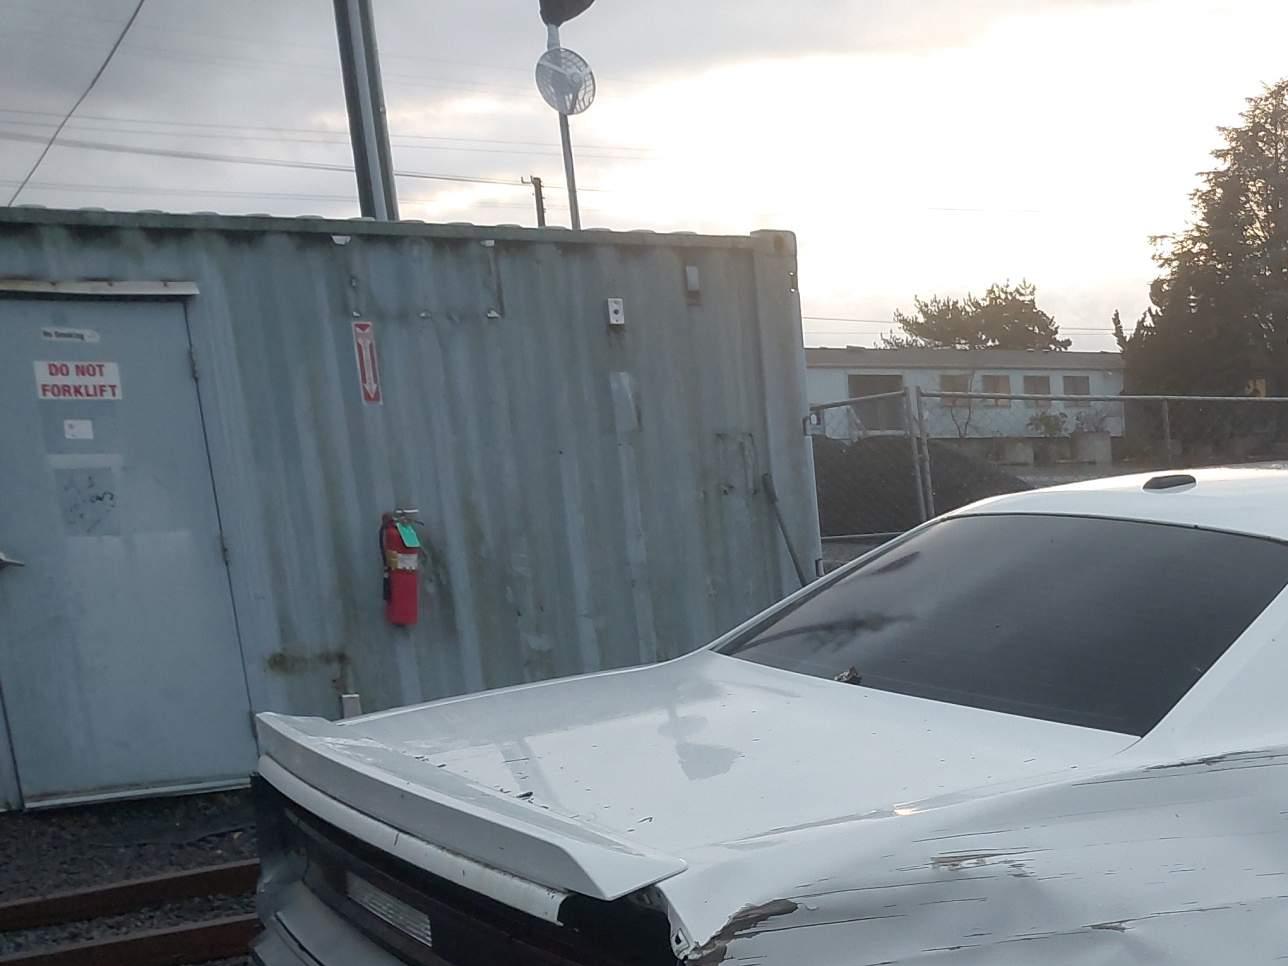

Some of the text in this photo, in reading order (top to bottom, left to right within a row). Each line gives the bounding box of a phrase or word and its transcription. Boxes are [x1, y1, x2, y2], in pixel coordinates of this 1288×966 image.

[48, 363, 104, 377] DO NOT
[41, 383, 117, 398] FORKLIFT
